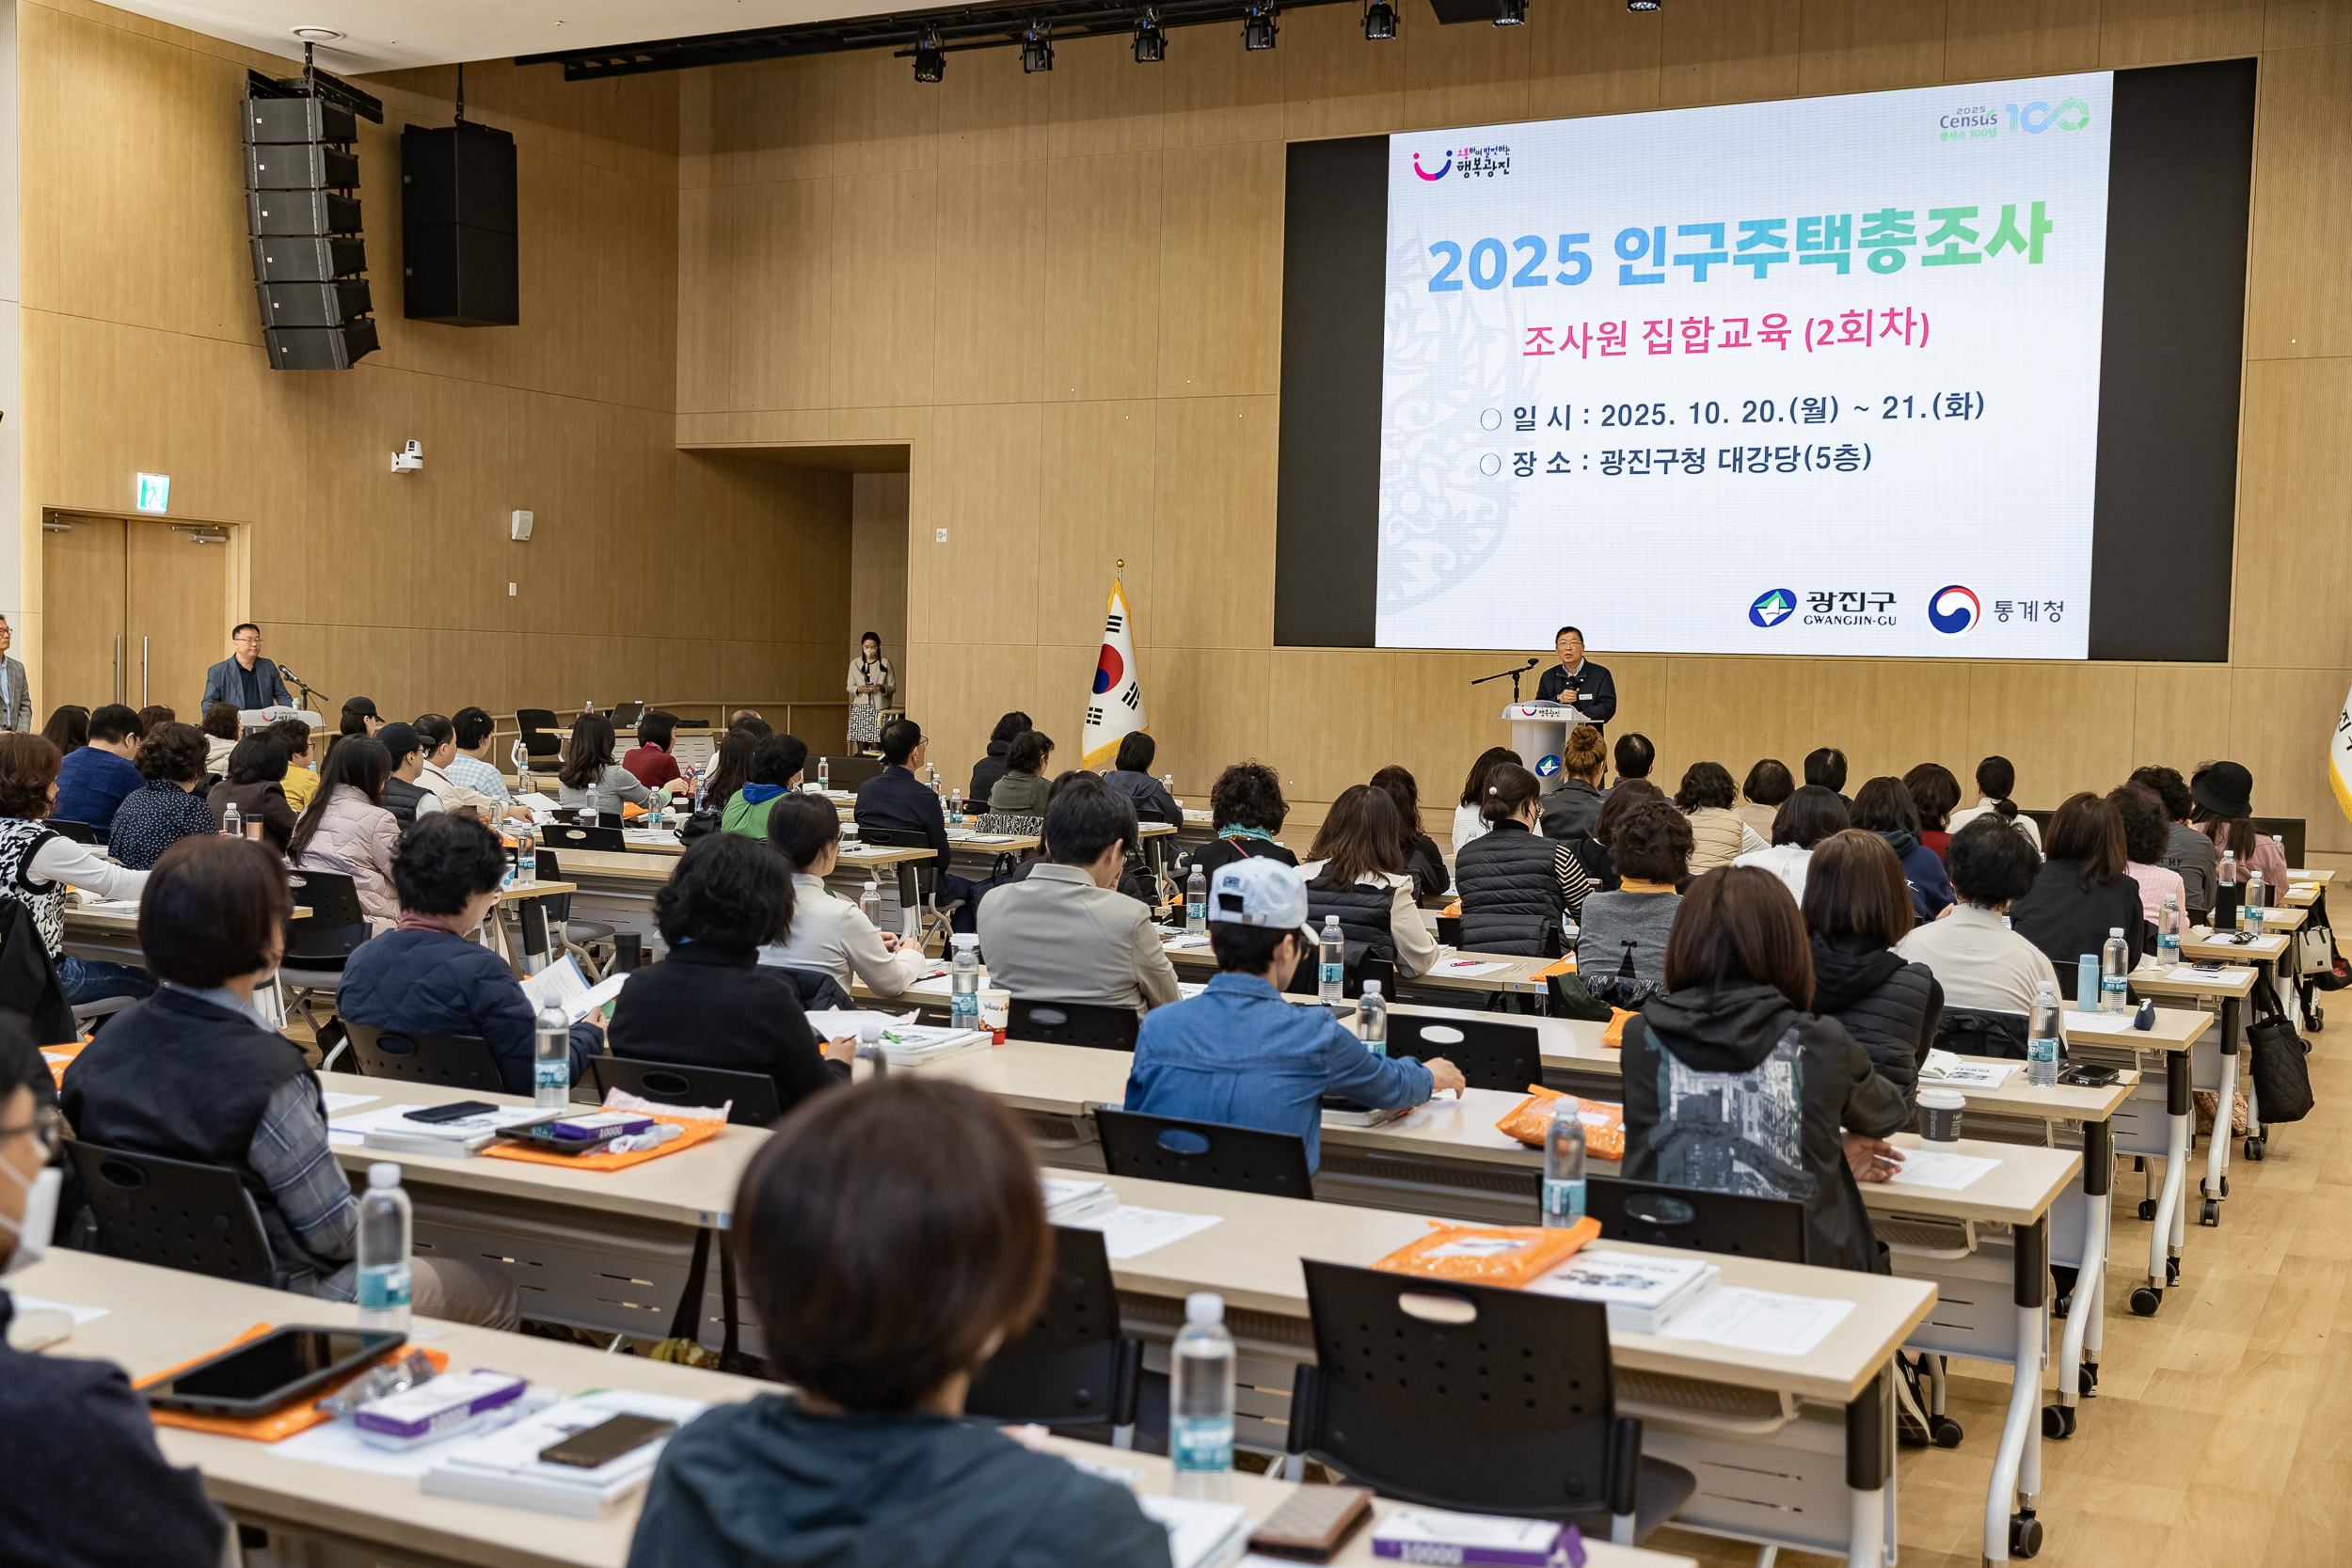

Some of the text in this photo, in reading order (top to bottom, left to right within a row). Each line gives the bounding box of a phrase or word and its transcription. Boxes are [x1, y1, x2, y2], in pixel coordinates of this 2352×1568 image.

[1940, 113, 1997, 130] Census
[1957, 106, 1986, 115] 2025
[1940, 127, 1997, 141] 센서스 100년
[1457, 145, 1511, 160] 소통하며 발전하는
[1456, 157, 1510, 179] 행복광진
[1428, 200, 2053, 293] 2025 인구주택총조사
[1522, 307, 1931, 359] 조사원 집합교육 (2회차)
[1513, 404, 1536, 432] 일
[1547, 404, 1571, 432] 시
[1600, 403, 1675, 427] 2025.
[1689, 402, 1729, 425] 10.
[1742, 396, 1839, 425] 20.(월)
[1883, 390, 1985, 421] 21.(화)
[1512, 451, 1537, 478] 장
[1546, 451, 1572, 474] 소
[1599, 448, 1706, 477] 광진구청
[1718, 442, 1872, 474] 대강당(5층)
[1806, 591, 1897, 613] 광진구
[1994, 600, 2064, 624] 통계청
[1803, 614, 1897, 626] GWANGJIN-GU
[598, 1126, 623, 1138] 10000
